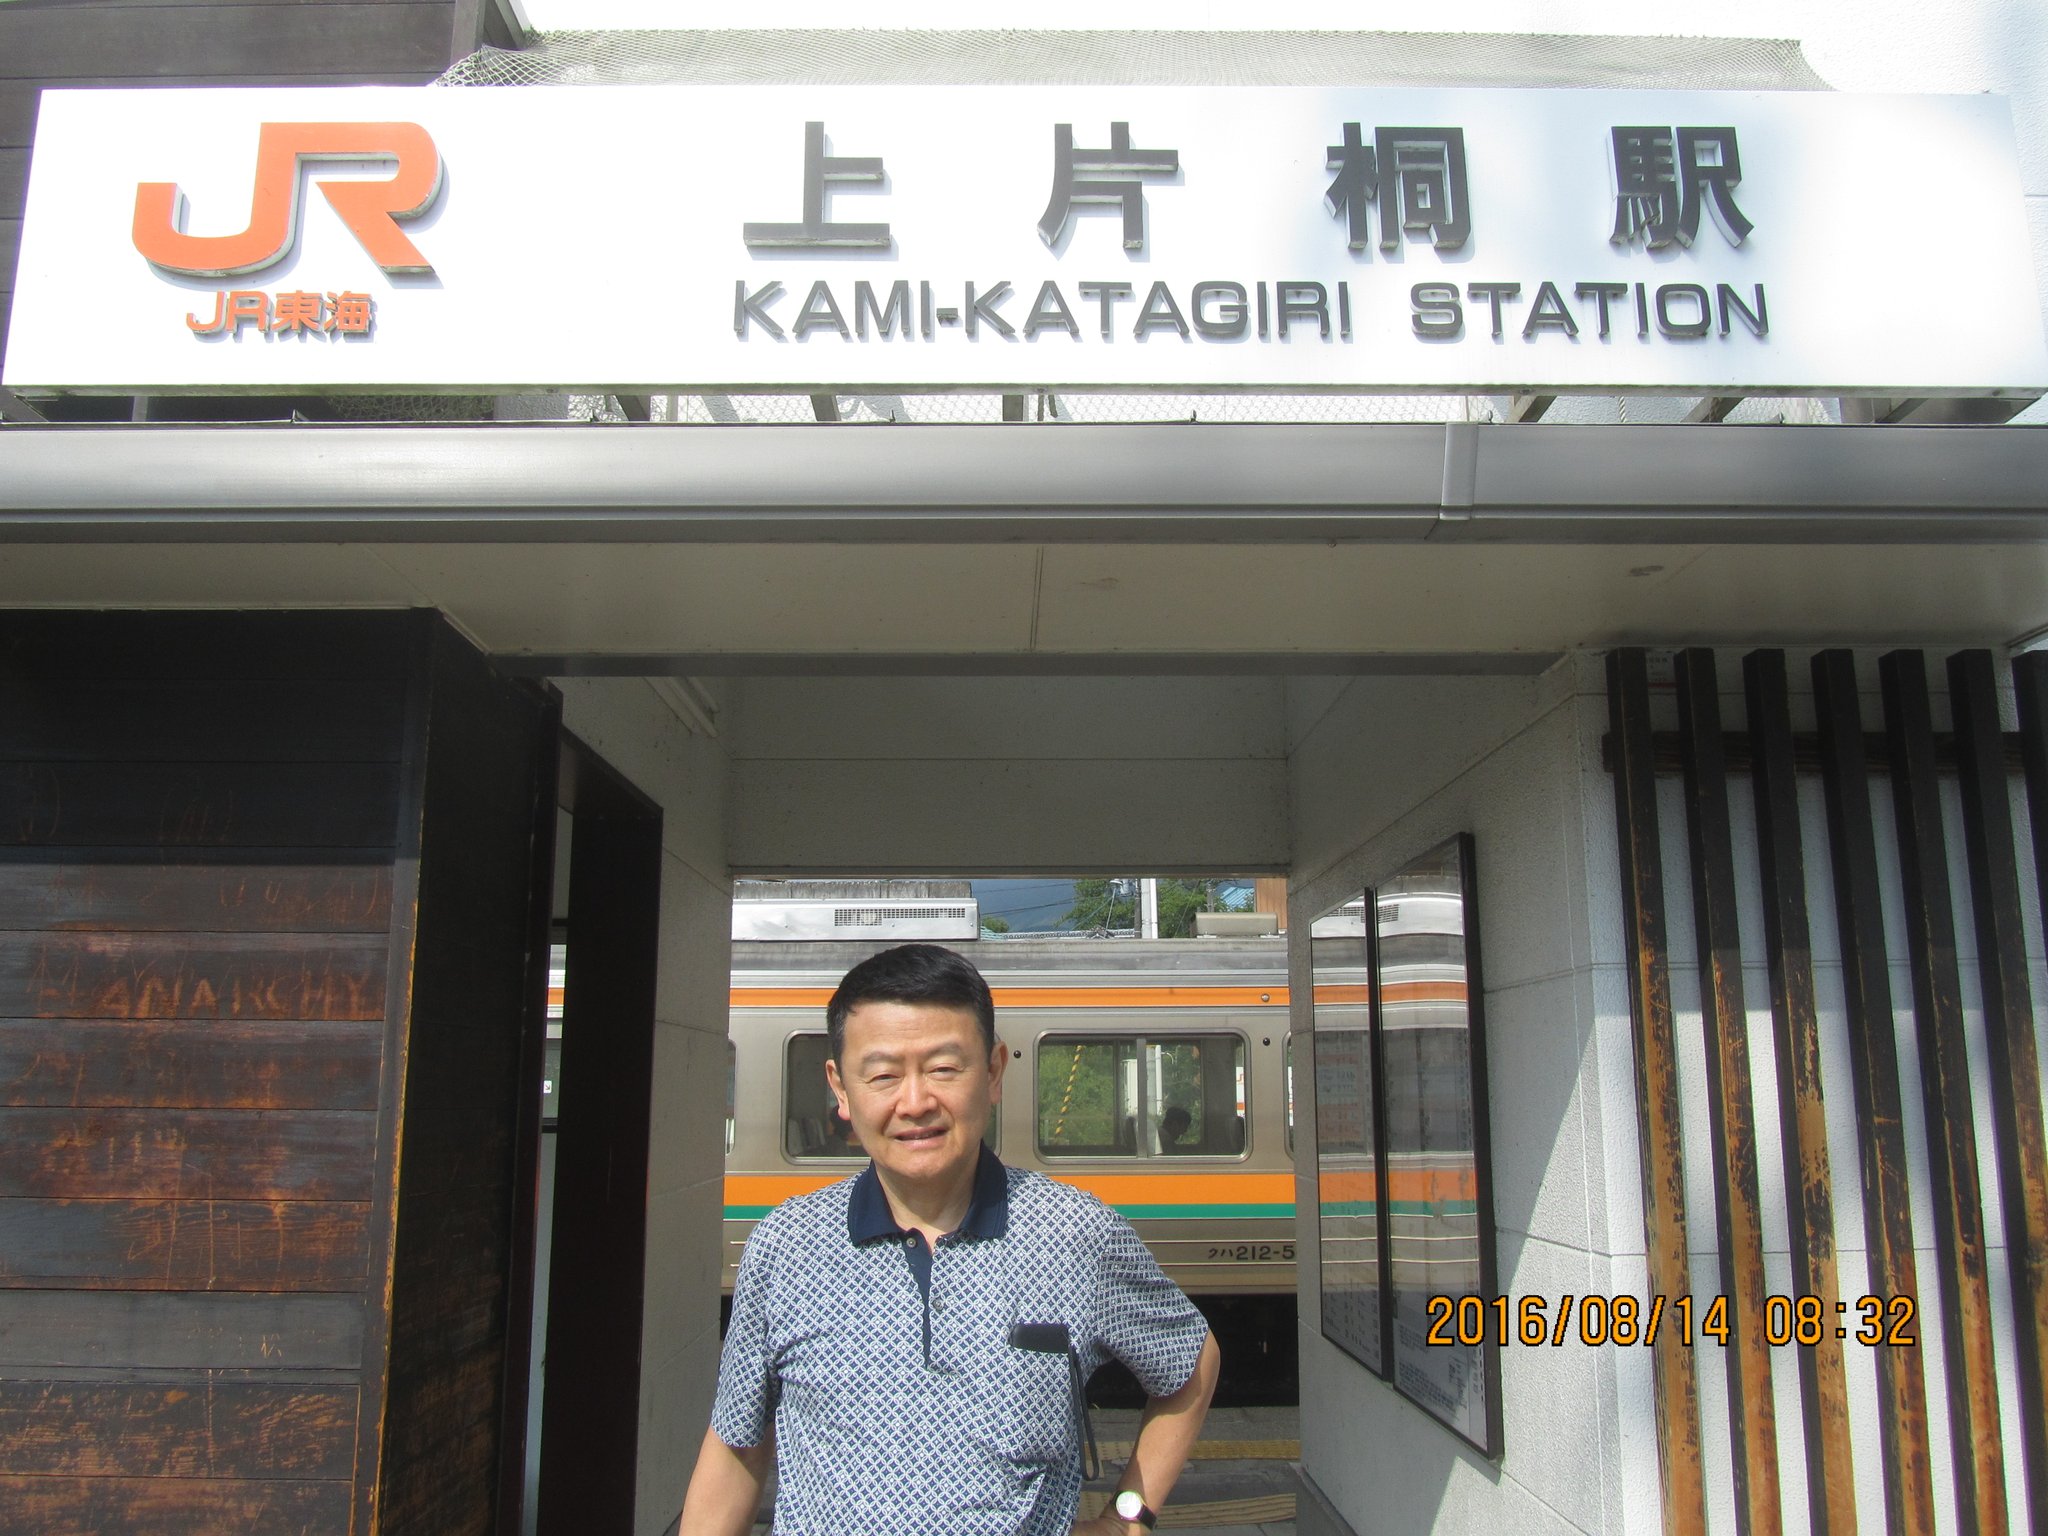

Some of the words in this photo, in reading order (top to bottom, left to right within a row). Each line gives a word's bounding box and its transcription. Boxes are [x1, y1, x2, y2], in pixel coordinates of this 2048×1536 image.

[132, 122, 443, 274] JR
[743, 121, 1754, 250] 上片桐駅
[186, 290, 376, 335] JR東海
[733, 280, 1352, 337] KAMI-KATAGIRI
[1410, 281, 1770, 338] STATION
